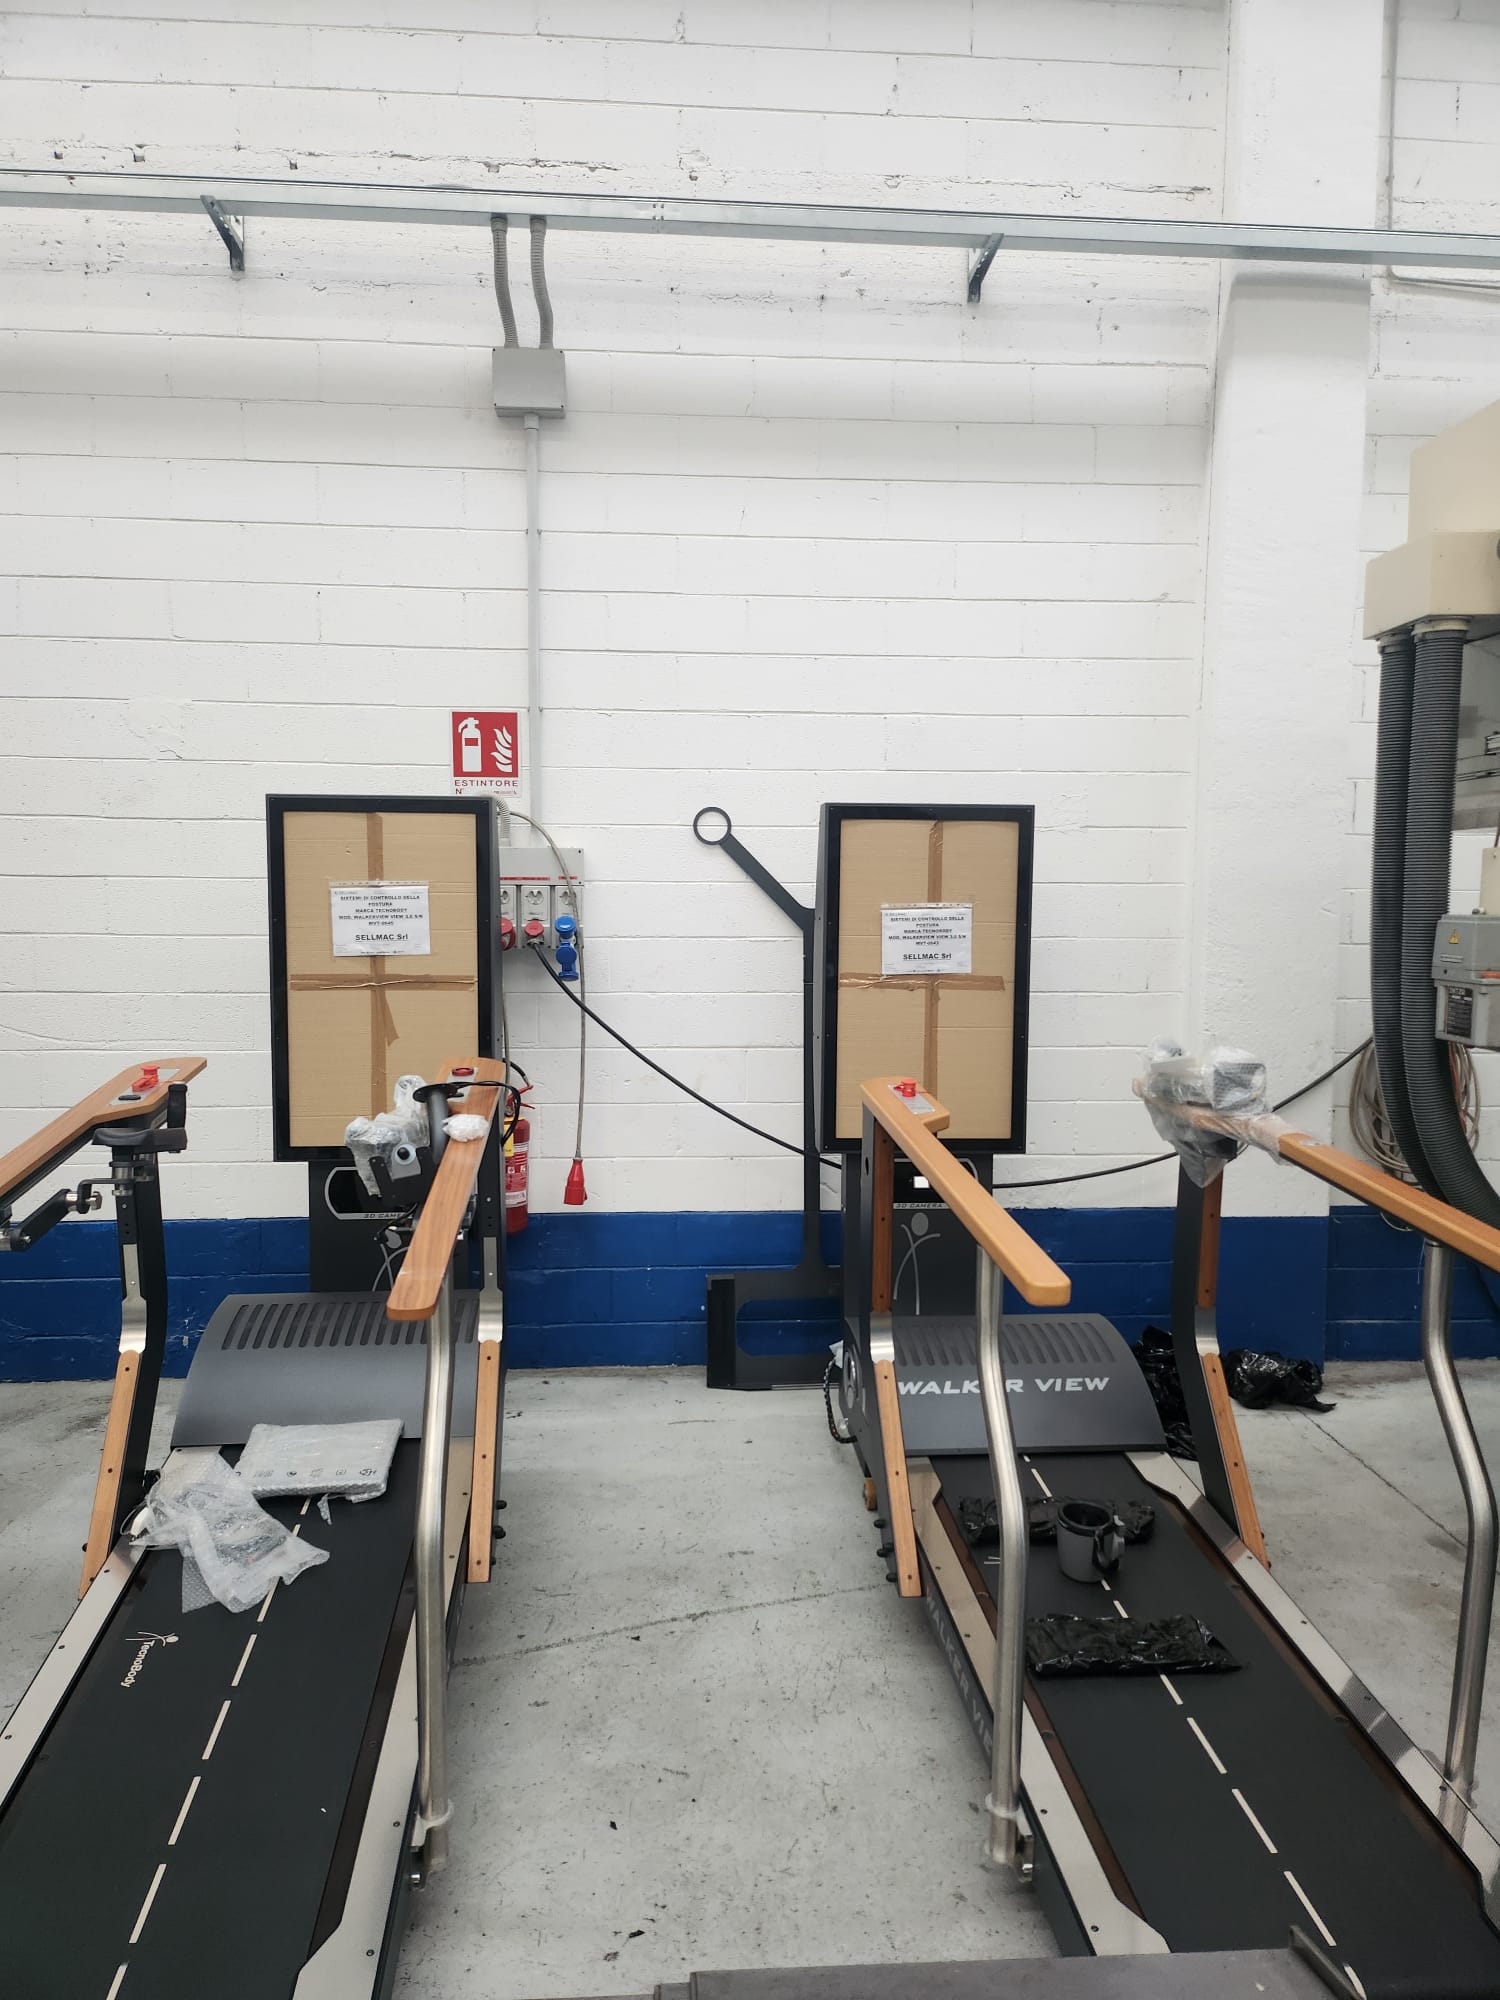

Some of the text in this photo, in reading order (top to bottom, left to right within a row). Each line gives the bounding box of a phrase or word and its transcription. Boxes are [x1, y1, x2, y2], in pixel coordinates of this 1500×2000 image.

[898, 1378, 1110, 1395] WALKR VIEW
[120, 1640, 155, 1688] TecnoBody
[972, 1699, 993, 1755] VIE
